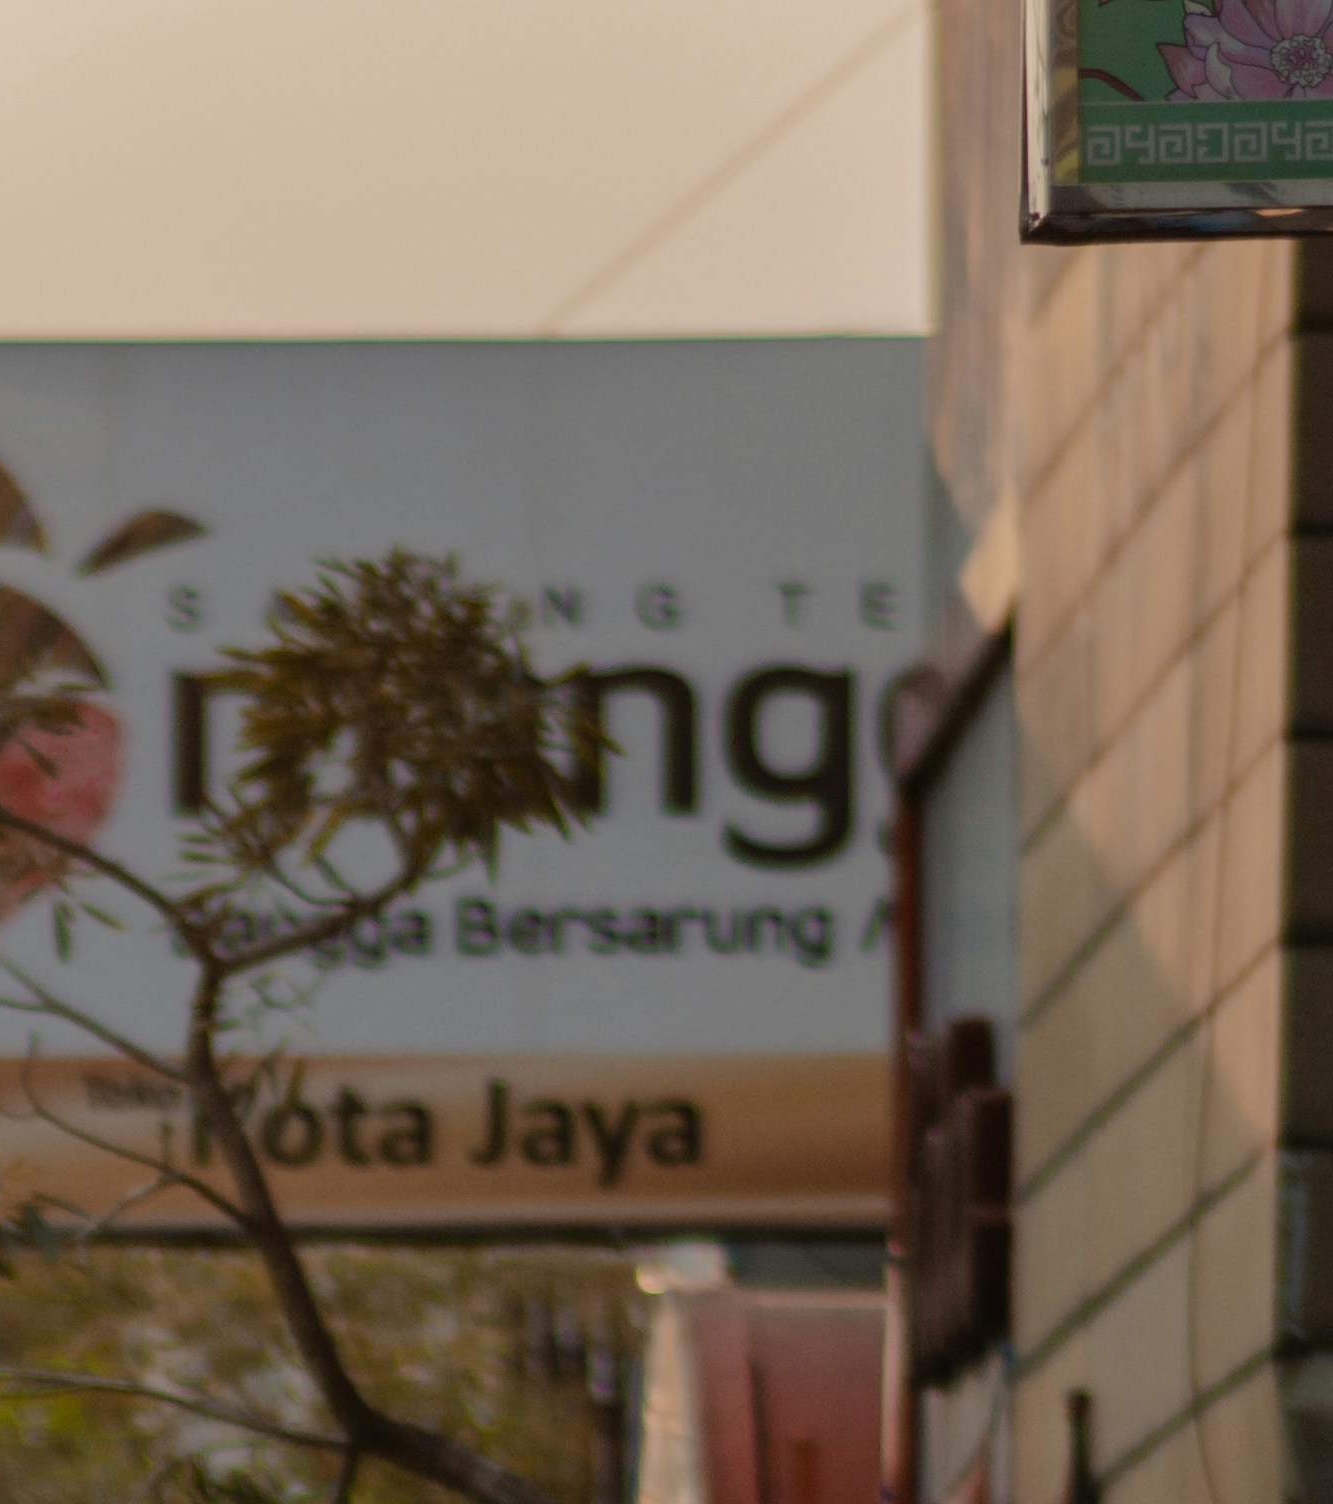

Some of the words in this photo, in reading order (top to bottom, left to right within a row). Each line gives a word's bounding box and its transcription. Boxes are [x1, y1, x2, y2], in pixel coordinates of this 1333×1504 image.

[165, 582, 681, 631] SNG
[454, 895, 834, 968] Bersarung
[470, 1078, 705, 1189] Jaya
